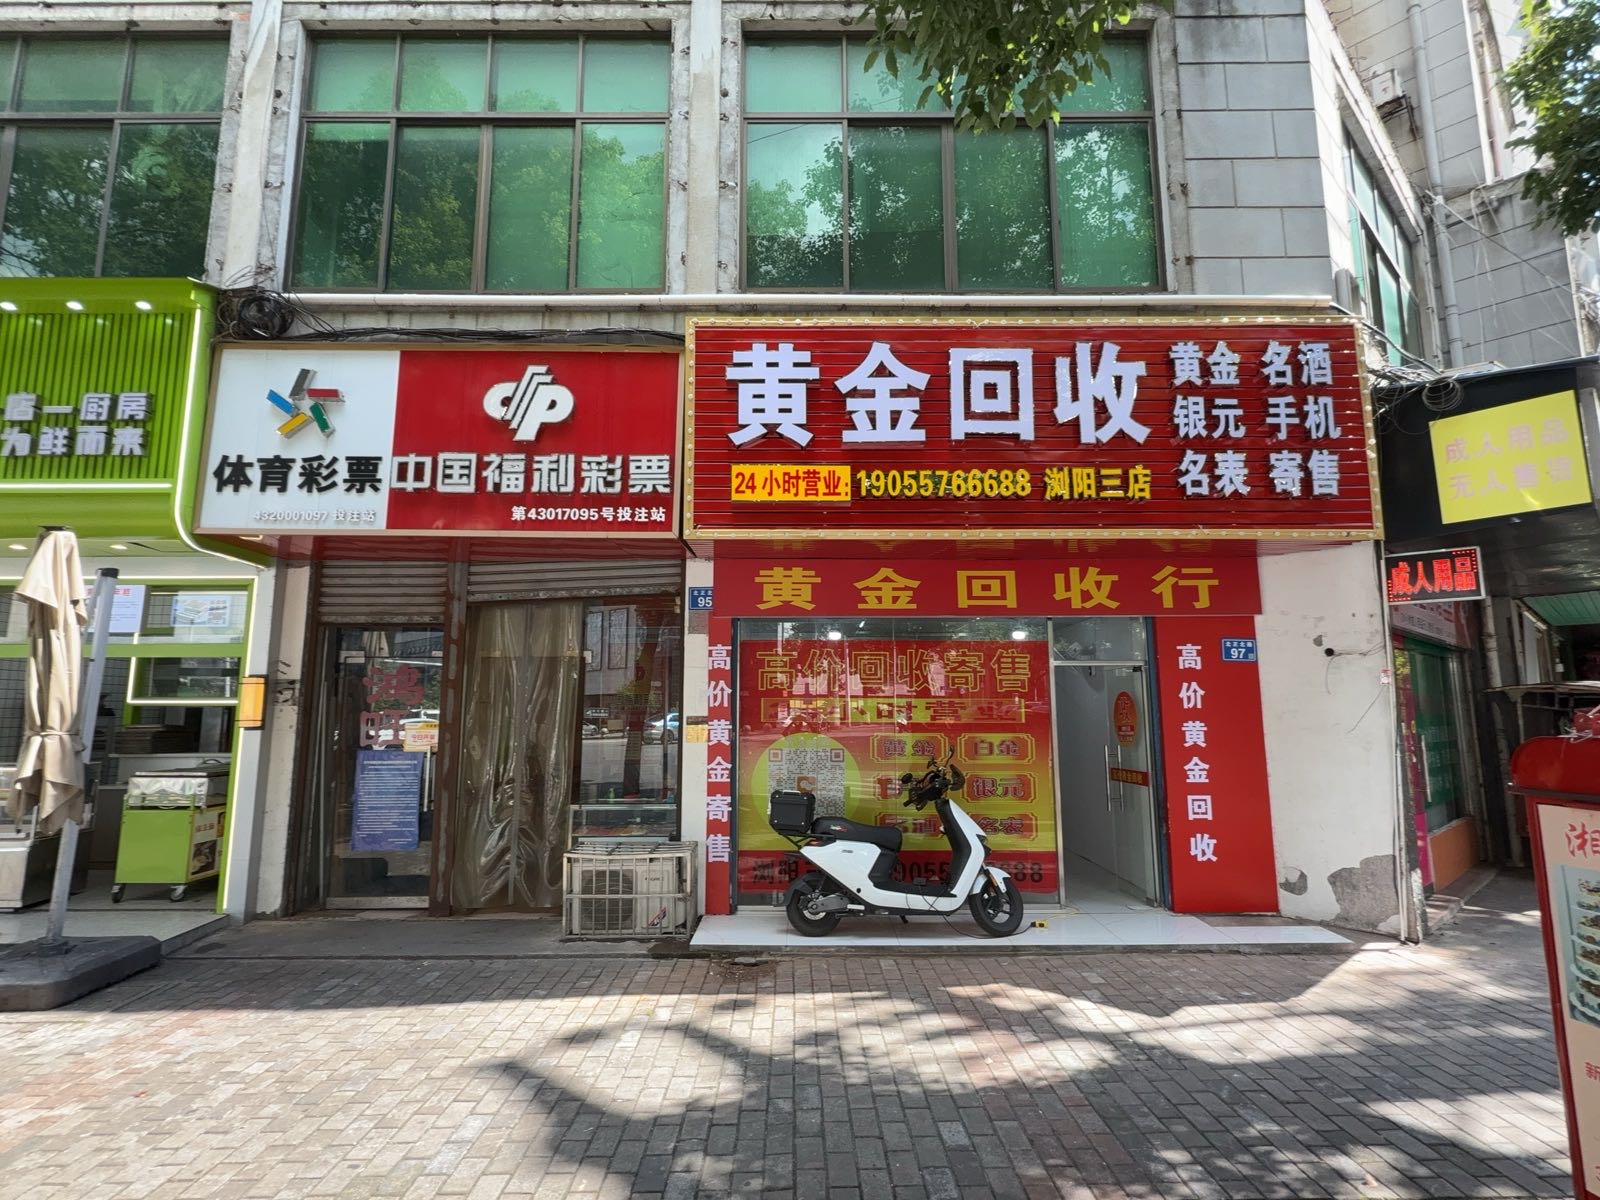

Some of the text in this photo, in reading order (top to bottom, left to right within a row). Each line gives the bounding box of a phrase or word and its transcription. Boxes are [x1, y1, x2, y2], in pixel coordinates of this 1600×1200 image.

[1170, 340, 1335, 388] 黄金 名酒
[725, 340, 1153, 448] 黄金回收
[1174, 395, 1342, 442] 银元 手机
[212, 454, 383, 494] 体育彩票
[391, 452, 672, 495] 中国福利彩票
[857, 467, 1152, 499] 19055766688 浏阳三店
[1178, 449, 1341, 498] 名表 寄售
[332, 509, 376, 522] 投注站
[511, 504, 667, 523] 第43017095号投注站
[754, 565, 1219, 610] 黄金回收行
[1391, 557, 1477, 595] 成人用品
[697, 597, 713, 607] 95
[757, 649, 1032, 693] 高价回收寄售
[1230, 648, 1246, 659] 97
[706, 645, 733, 863] 高价黄金寄售
[884, 740, 937, 757] 黄金
[1177, 644, 1218, 862] 高价黄金回收
[972, 777, 1025, 798] 银元
